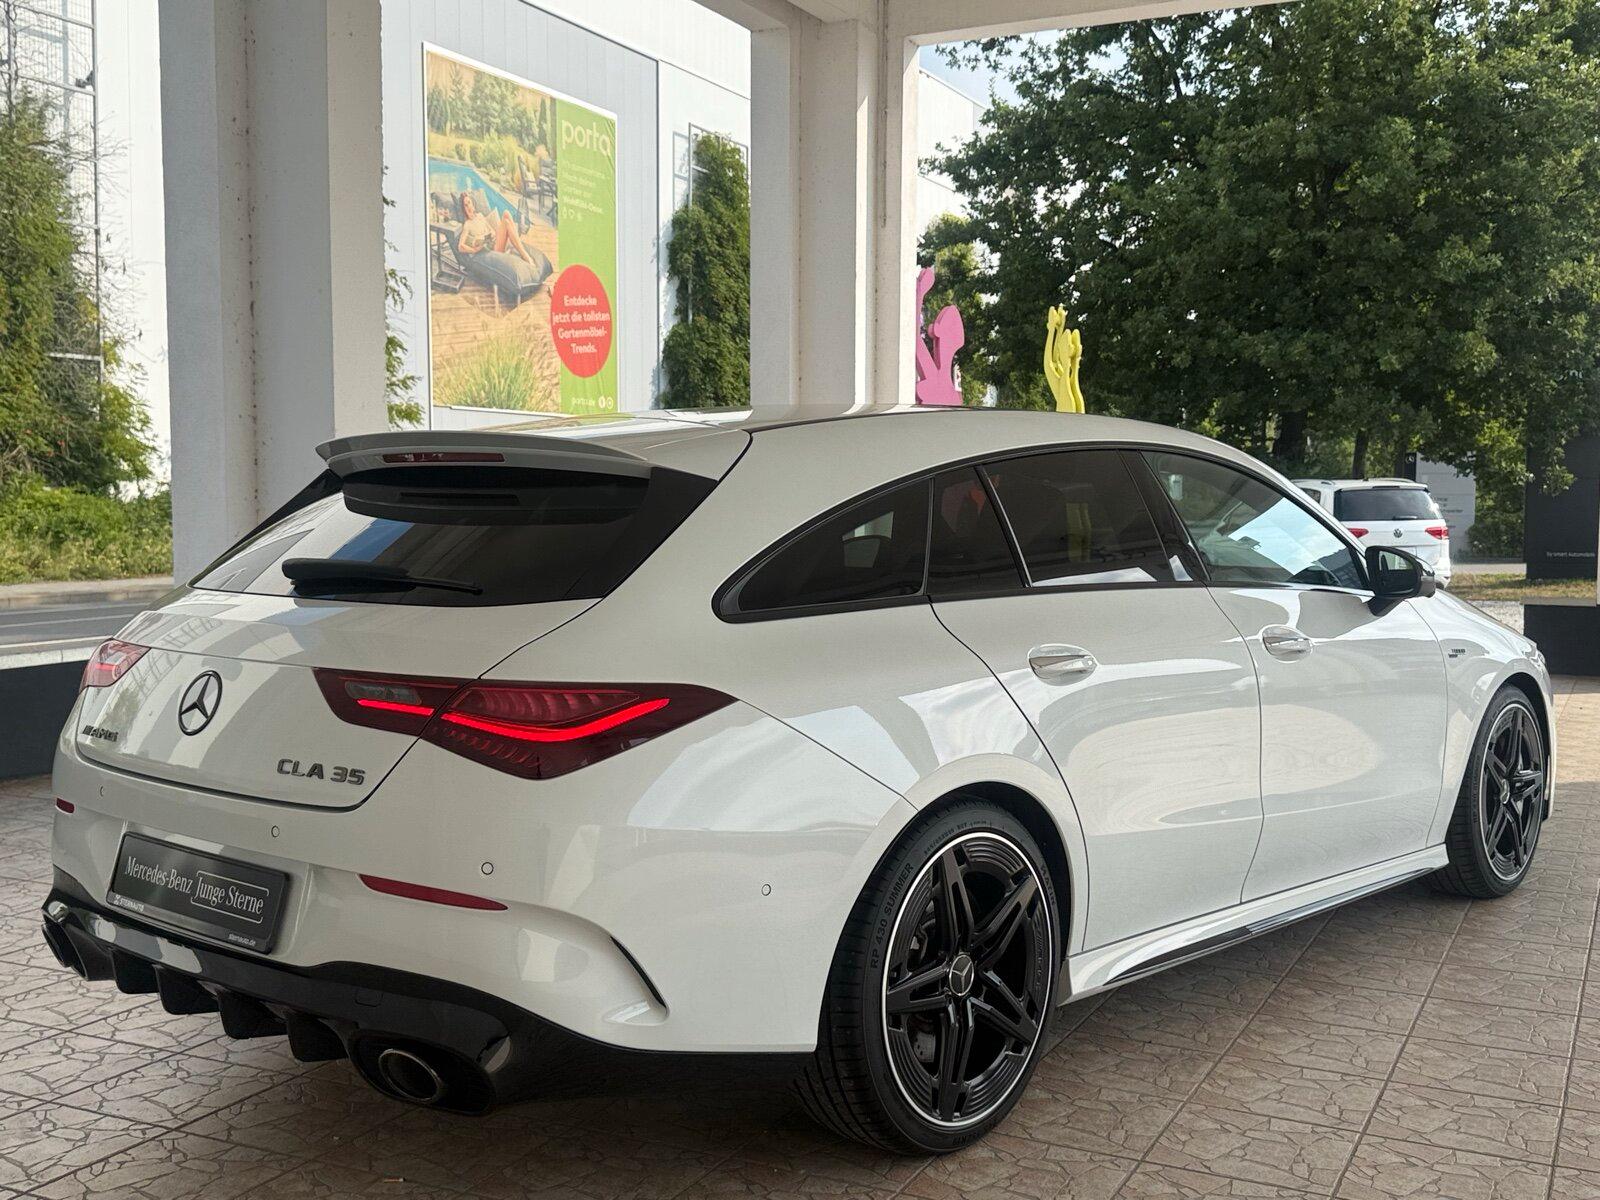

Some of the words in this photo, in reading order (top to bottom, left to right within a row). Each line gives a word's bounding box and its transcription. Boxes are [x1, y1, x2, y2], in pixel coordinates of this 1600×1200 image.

[561, 119, 611, 158] porta
[563, 294, 597, 306] Entdecke
[552, 312, 570, 325] jetzt
[571, 311, 582, 322] die
[583, 310, 611, 322] tollsten
[277, 758, 324, 780] CLA
[330, 766, 366, 786] 35
[125, 856, 194, 894] Mercedes-Benz
[194, 876, 226, 906] Junge
[226, 885, 264, 915] Sterne
[870, 948, 880, 969] RP
[875, 918, 888, 945] 430
[884, 862, 915, 916] SUMMER
